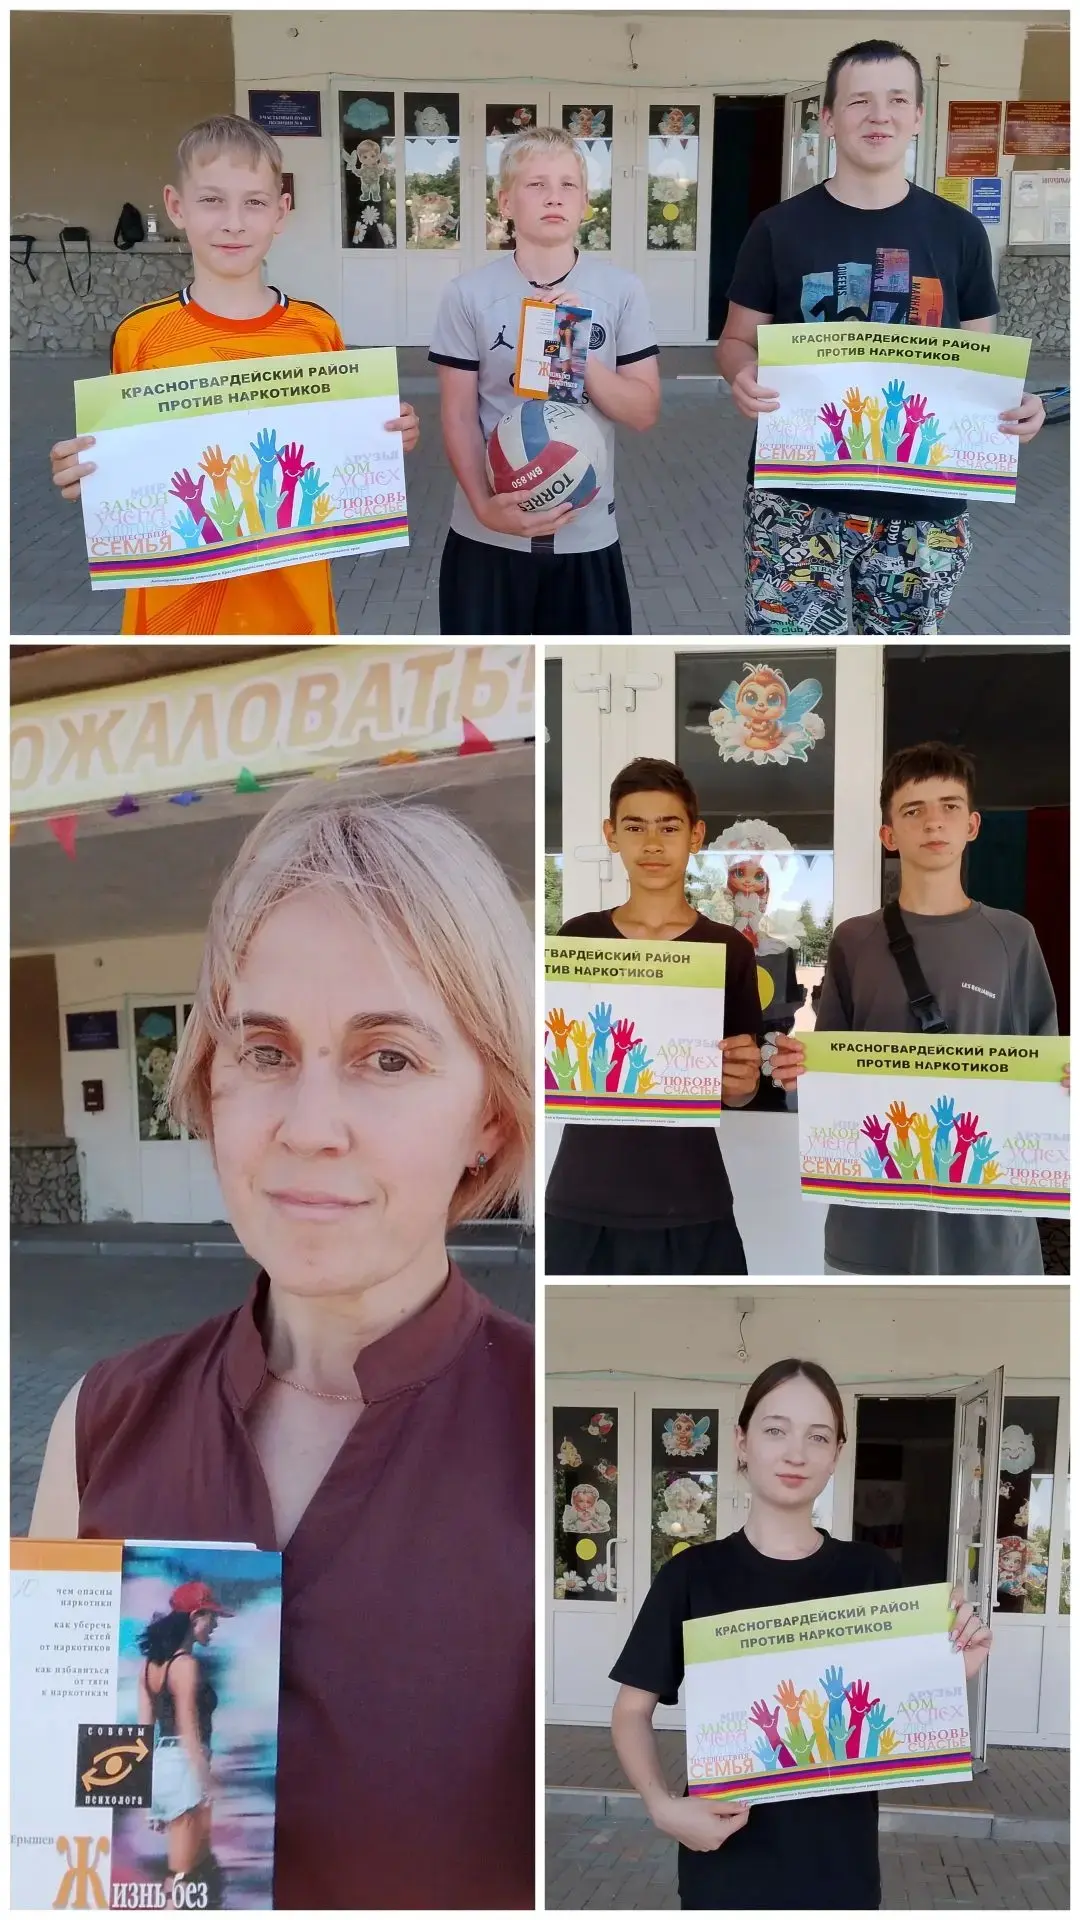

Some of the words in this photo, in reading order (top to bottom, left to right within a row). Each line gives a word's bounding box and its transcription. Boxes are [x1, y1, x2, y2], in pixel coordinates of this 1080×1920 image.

[791, 332, 938, 348] КРАСНОГВАРДЕЙСКИЙ
[942, 337, 991, 353] РАЙОН
[817, 346, 866, 358] ПРОТИВ
[869, 348, 960, 362] НАРКОТИКОВ
[121, 366, 304, 400] КРАСНОГВАРДЕЙСКИЙ
[308, 363, 360, 377] РАЙОН
[158, 394, 224, 413] ПРОТИВ
[228, 383, 331, 403] НАРКОТИКОВ
[759, 447, 816, 461] СЕМЬЯ
[951, 448, 1017, 463] ЛЮБОВЬ
[527, 466, 543, 481] BM
[512, 476, 528, 489] 850
[517, 473, 574, 512] TORRES
[335, 492, 406, 510] ЛЮБОВЬ
[91, 534, 172, 556] СЕМЬЯ
[545, 948, 640, 962] ГВАРДЕЙСКИЙ
[645, 952, 690, 964] РАЙОН
[545, 964, 570, 974] ТИВ
[574, 966, 664, 978] НАРКОТИКОВ
[830, 1042, 984, 1056] КРАСНОГВАРДЕЙСКИЙ
[988, 1045, 1039, 1058] РАЙОН
[856, 1059, 910, 1069] ПРОТИВ
[915, 1061, 1009, 1073] НАРКОТИКОВ
[661, 1076, 721, 1086] ЛЮБОВЬ
[664, 1086, 720, 1095] СЧАСТЬЕ
[803, 1160, 862, 1176] СЕМЬЯ
[1006, 1168, 1070, 1180] ЛЮБОВЬ
[1010, 1177, 1068, 1188] СЧАСТЬЕ
[56, 1588, 74, 1596] чем
[77, 1588, 112, 1596] опасны
[60, 1600, 112, 1608] наркотики
[74, 1620, 112, 1630] уберечь
[714, 1605, 866, 1637] КРАСНОГВАРДЕЙСКИЙ
[870, 1600, 920, 1614] РАЙОН
[84, 1632, 111, 1640] детей
[740, 1632, 795, 1649] ПРОТИВ
[799, 1620, 893, 1643] НАРКОТИКОВ
[54, 1644, 111, 1652] наркотиков
[55, 1665, 109, 1674] избавиться
[51, 1690, 108, 1698] наркотикам
[903, 1728, 969, 1743] ЛЮБОВЬ
[908, 1738, 966, 1752] СЧАСТЬЕ
[690, 1758, 754, 1778] СЕМЬЯ
[85, 1794, 143, 1806] психолога
[171, 1872, 208, 1909] без
